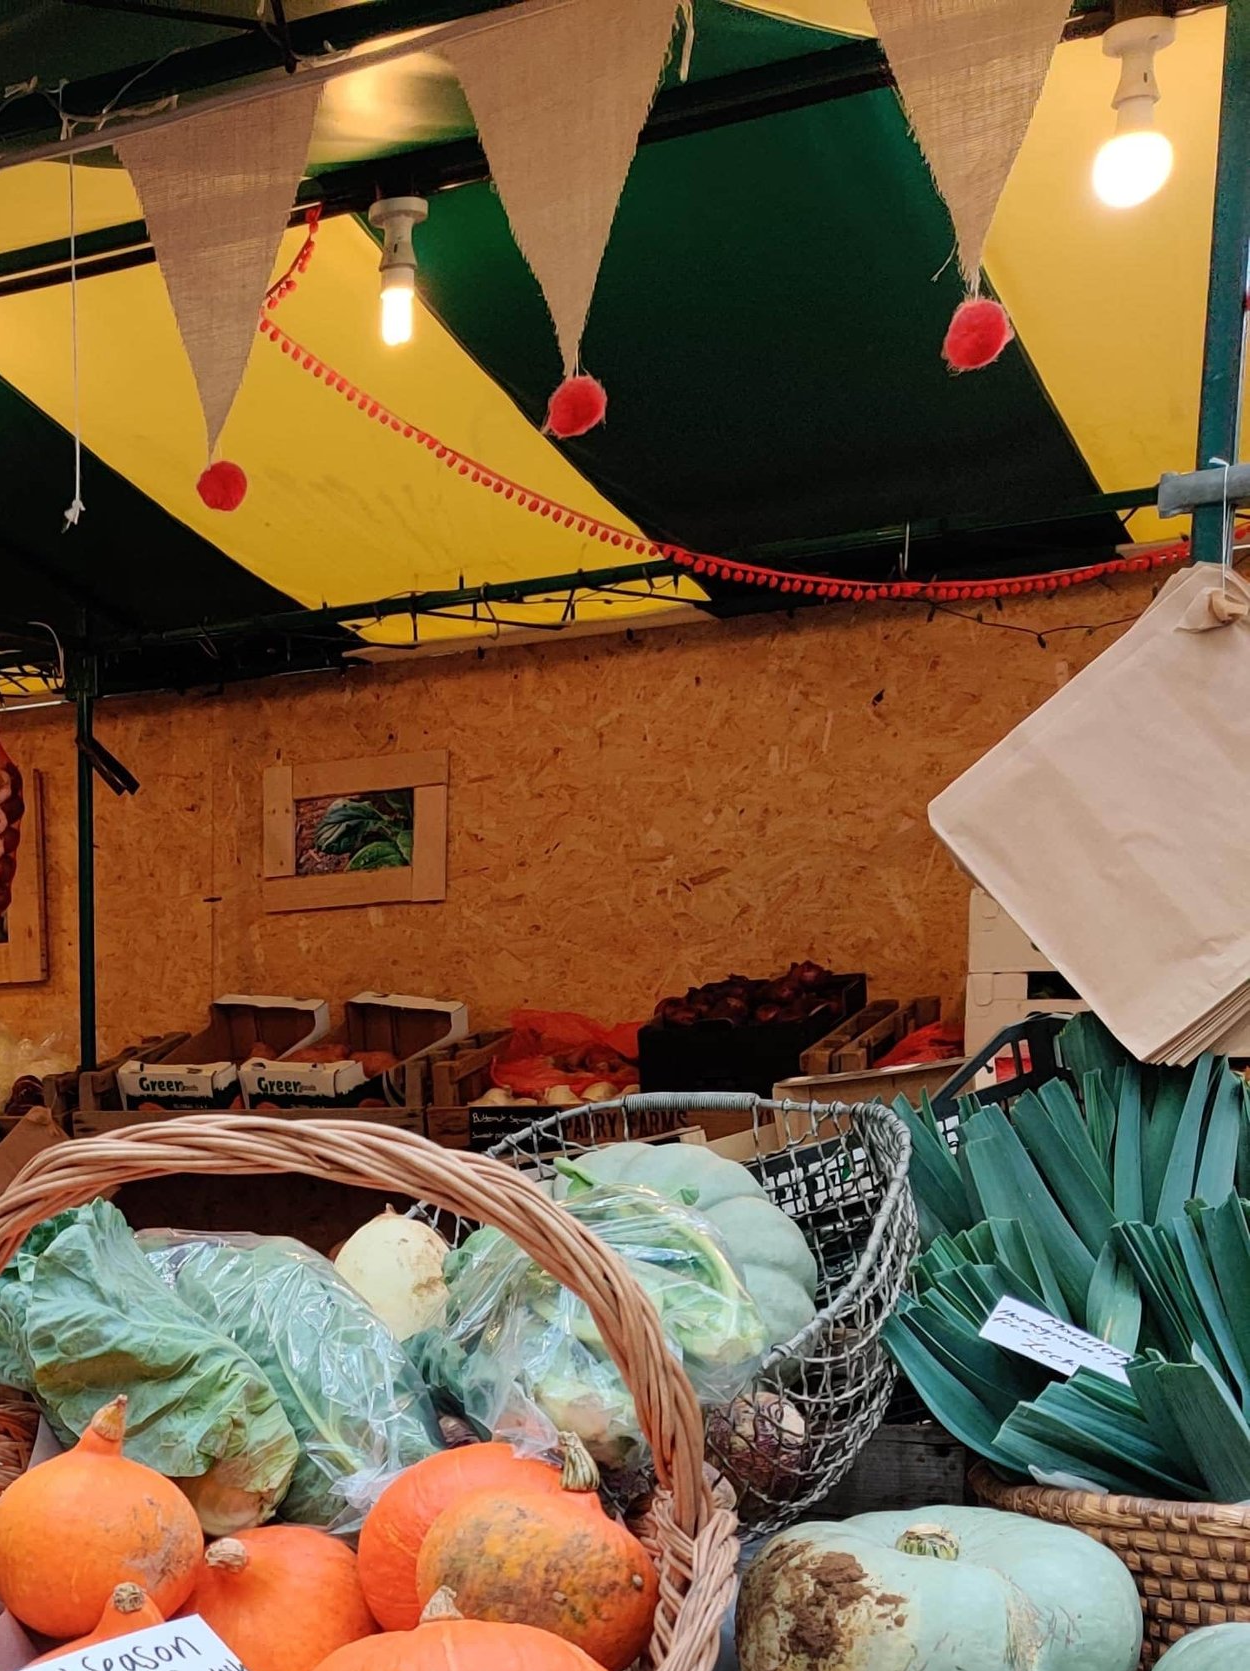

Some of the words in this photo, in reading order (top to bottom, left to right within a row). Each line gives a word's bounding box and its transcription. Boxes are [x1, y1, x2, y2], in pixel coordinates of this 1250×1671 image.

[139, 1076, 183, 1092] Green
[257, 1076, 302, 1093] Green
[627, 1109, 689, 1137] FARMS
